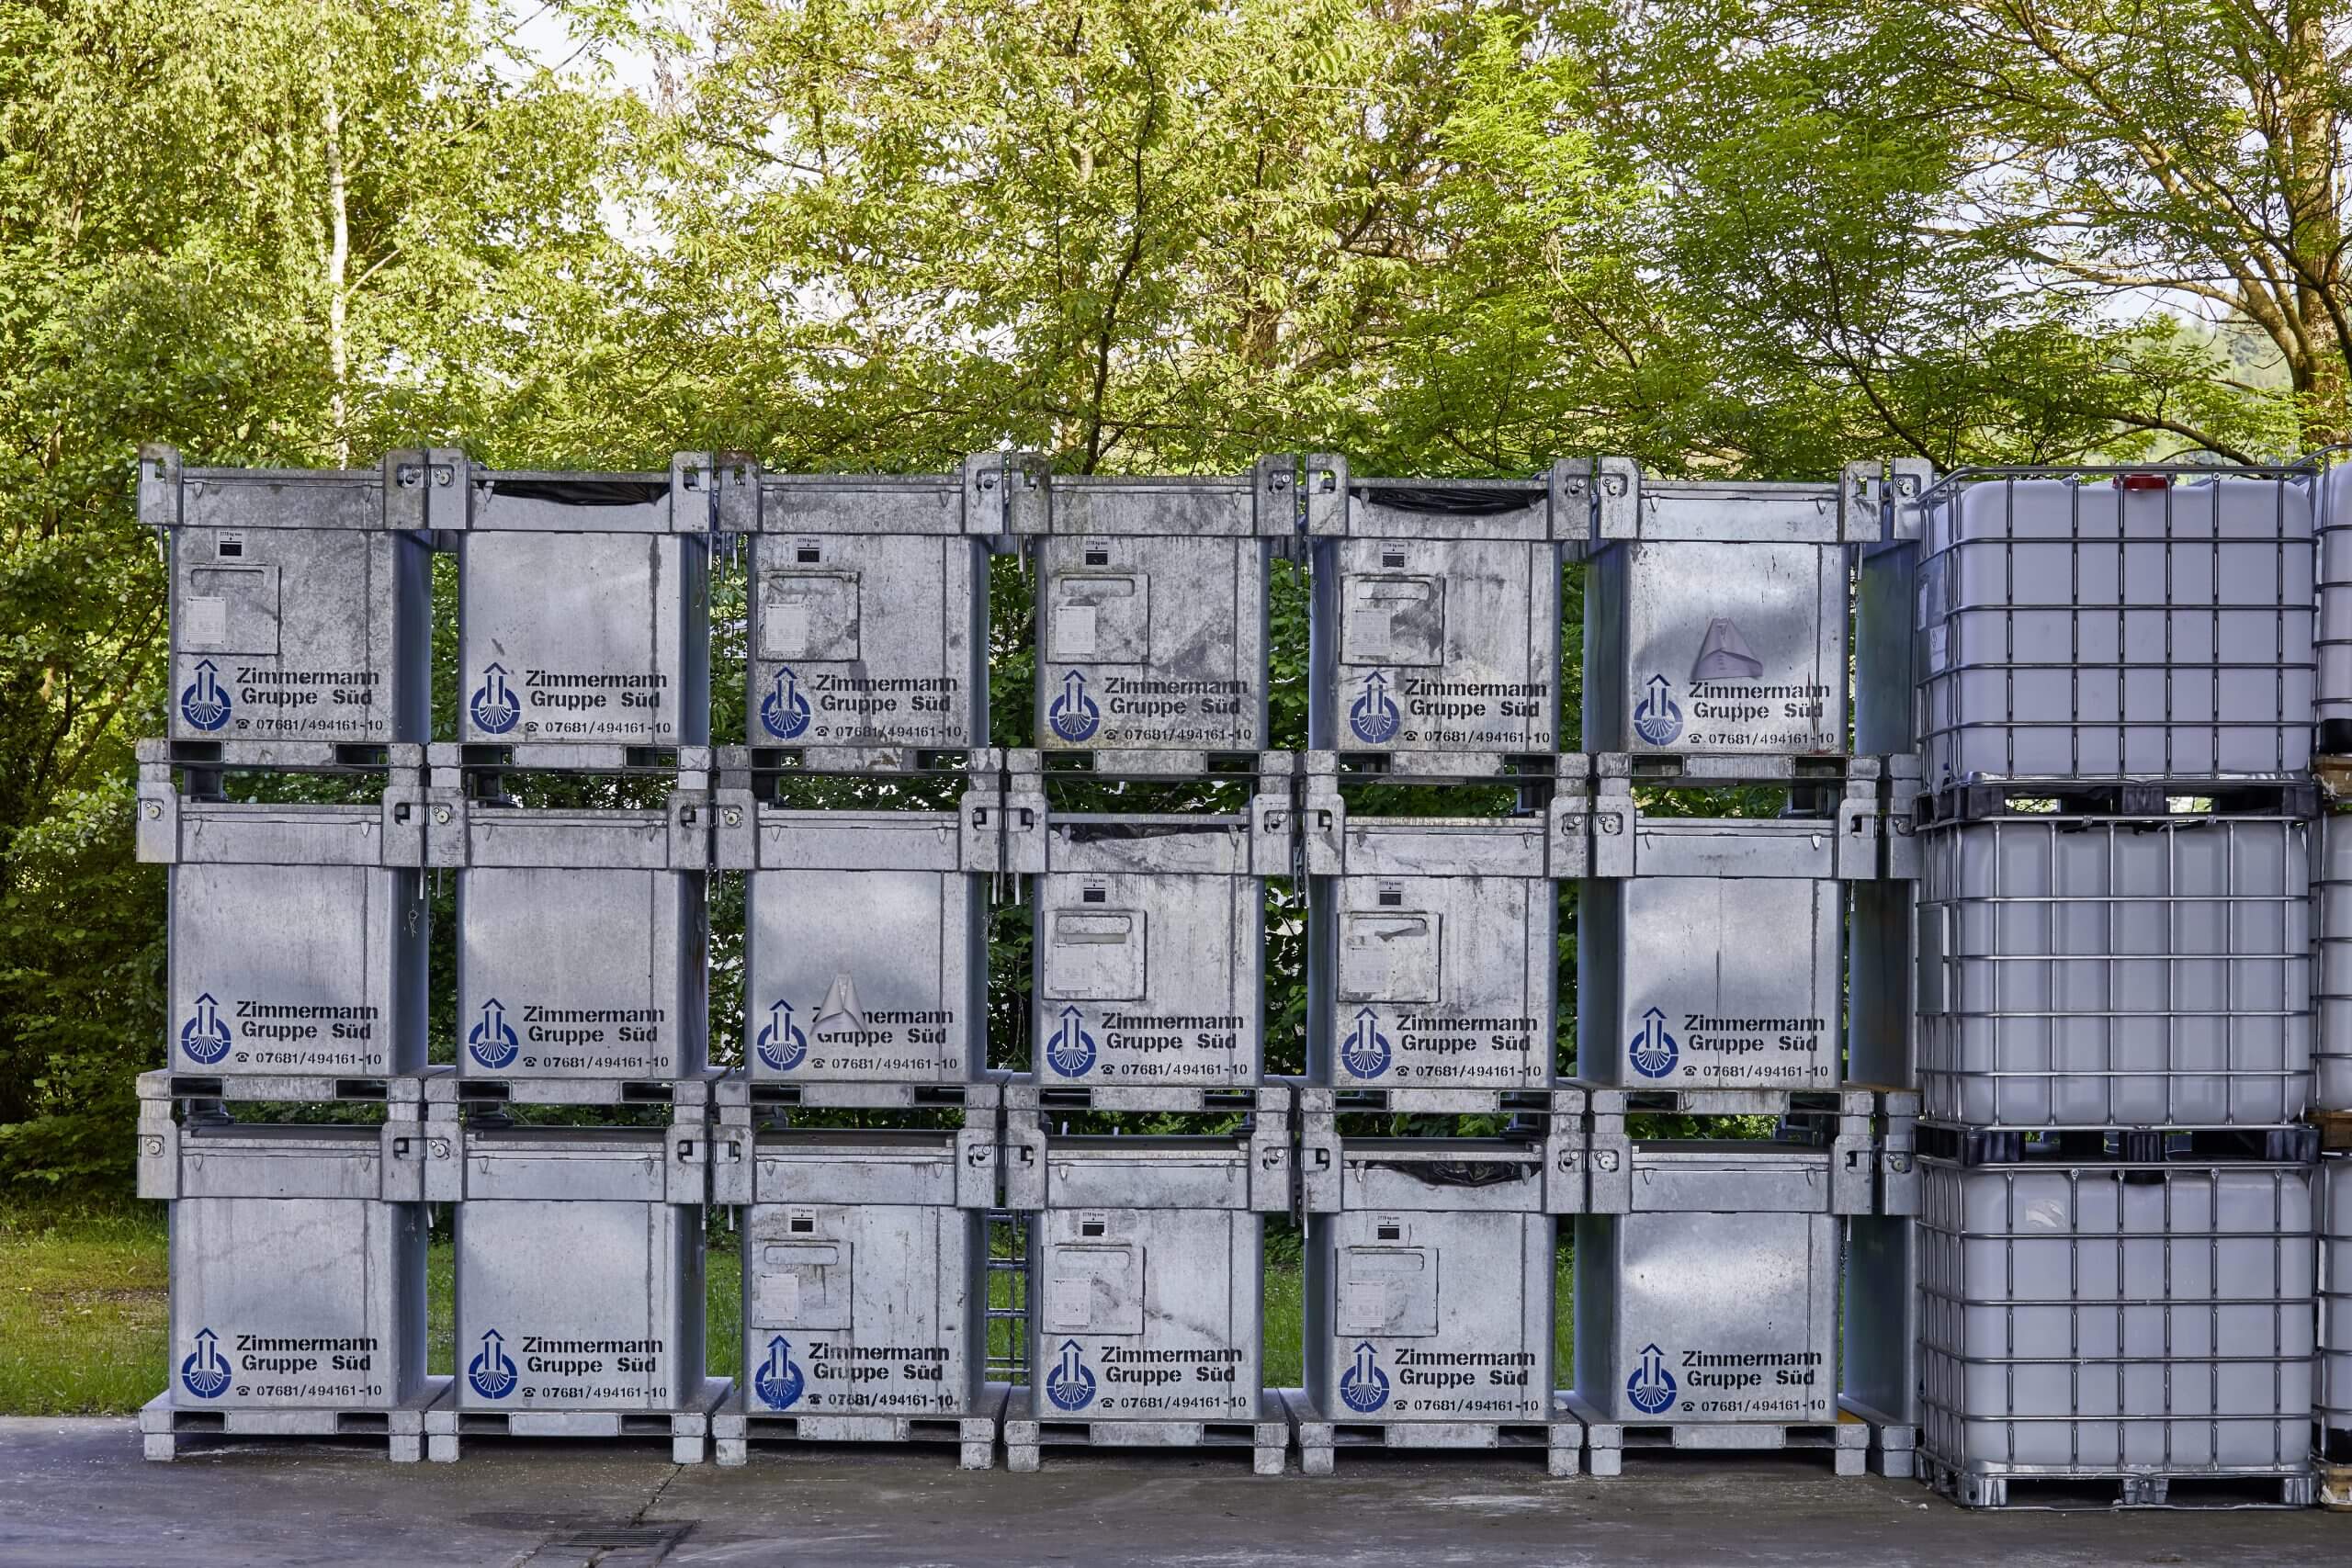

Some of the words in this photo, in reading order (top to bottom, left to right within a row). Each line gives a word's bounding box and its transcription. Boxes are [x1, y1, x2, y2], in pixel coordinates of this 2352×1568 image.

[236, 667, 379, 686] Zimmermann
[525, 671, 667, 688] Zimmermann
[815, 674, 957, 692] Zimmermann
[1104, 677, 1248, 694] Zimmermann
[1405, 679, 1547, 697] Zimmermann
[1689, 682, 1828, 699] Zimmermann
[242, 688, 318, 708] Gruppe
[333, 688, 372, 705] Süd
[530, 691, 606, 711] Gruppe
[621, 691, 661, 707] Süd
[820, 694, 897, 715] Gruppe
[911, 694, 951, 711] Süd
[1110, 698, 1186, 717] Gruppe
[1201, 697, 1241, 715] Süd
[1409, 699, 1486, 720] Gruppe
[1499, 700, 1540, 717] Süd
[1694, 702, 1769, 722] Gruppe
[1783, 702, 1822, 718] Süd
[255, 717, 383, 732] 07681/494161-10
[545, 720, 672, 735] 07681/494161-10
[835, 725, 962, 739] 07681/494161-10
[1125, 728, 1251, 741] 07681/494161-10
[1424, 729, 1550, 744] 07681/494161-10
[1708, 732, 1833, 745] 07681/494161-10
[236, 1000, 379, 1020] Zimmermann
[523, 1006, 664, 1022] Zimmermann
[1102, 1012, 1243, 1029] Zimmermann
[1396, 1014, 1537, 1032] Zimmermann
[1684, 1014, 1825, 1032] Zimmermann
[242, 1021, 317, 1042] Gruppe
[332, 1022, 371, 1039] Süd
[528, 1026, 604, 1045] Gruppe
[618, 1025, 658, 1043] Süd
[907, 1027, 947, 1043] Süd
[1106, 1032, 1182, 1053] Gruppe
[1197, 1032, 1237, 1049] Süd
[1401, 1035, 1476, 1055] Gruppe
[1491, 1034, 1531, 1051] Süd
[1689, 1035, 1764, 1055] Gruppe
[1778, 1034, 1817, 1051] Süd
[255, 1051, 382, 1066] 07681/494161-10
[543, 1055, 669, 1069] 07681/494161-10
[831, 1057, 957, 1071] 07681/494161-10
[1121, 1063, 1248, 1076] 07681/494161-10
[1416, 1065, 1541, 1077] 07681/494161-10
[1702, 1065, 1827, 1078] 07681/494161-10
[236, 1335, 378, 1351] Zimmermann
[522, 1337, 662, 1353] Zimmermann
[808, 1343, 949, 1361] Zimmermann
[1101, 1346, 1242, 1363] Zimmermann
[1395, 1348, 1535, 1366] Zimmermann
[1681, 1349, 1822, 1367] Zimmermann
[242, 1355, 317, 1374] Gruppe
[332, 1354, 371, 1371] Süd
[527, 1357, 603, 1376] Gruppe
[616, 1356, 656, 1372] Süd
[813, 1363, 888, 1383] Gruppe
[903, 1363, 943, 1381] Süd
[1106, 1366, 1182, 1386] Gruppe
[1196, 1365, 1236, 1382] Süd
[1399, 1369, 1475, 1389] Gruppe
[1488, 1369, 1529, 1386] Süd
[1687, 1370, 1761, 1390] Gruppe
[1776, 1369, 1815, 1385] Süd
[256, 1384, 382, 1397] 07681/494161-10
[542, 1386, 667, 1399] 07681/494161-10
[1121, 1395, 1247, 1409] 07681/494161-10
[1413, 1399, 1539, 1413] 07681/494161-10
[1701, 1399, 1826, 1413] 07681/494161-10
